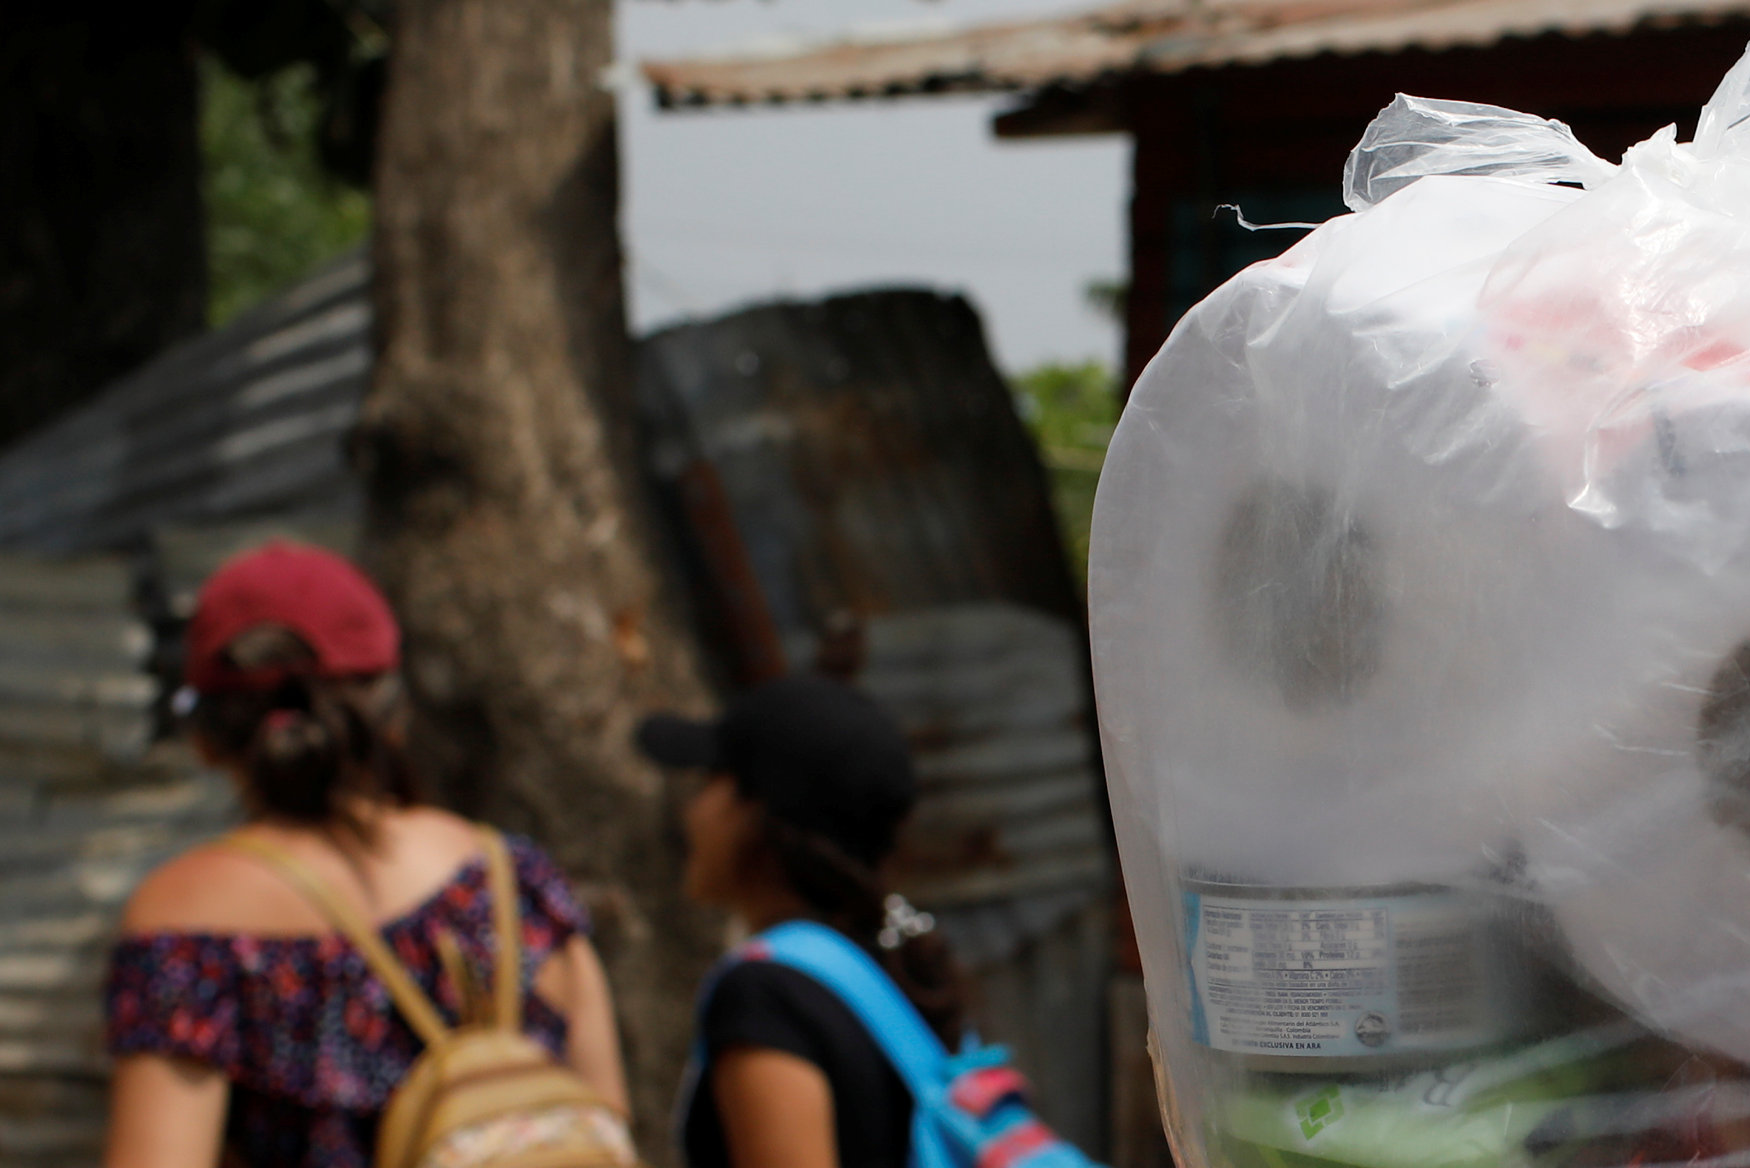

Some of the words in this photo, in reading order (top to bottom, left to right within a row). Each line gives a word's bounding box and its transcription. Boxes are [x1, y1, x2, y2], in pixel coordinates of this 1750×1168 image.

[1259, 1041, 1294, 1050] EXCLUSIVA
[1295, 1041, 1305, 1050] EN
[1305, 1041, 1321, 1049] ARA
